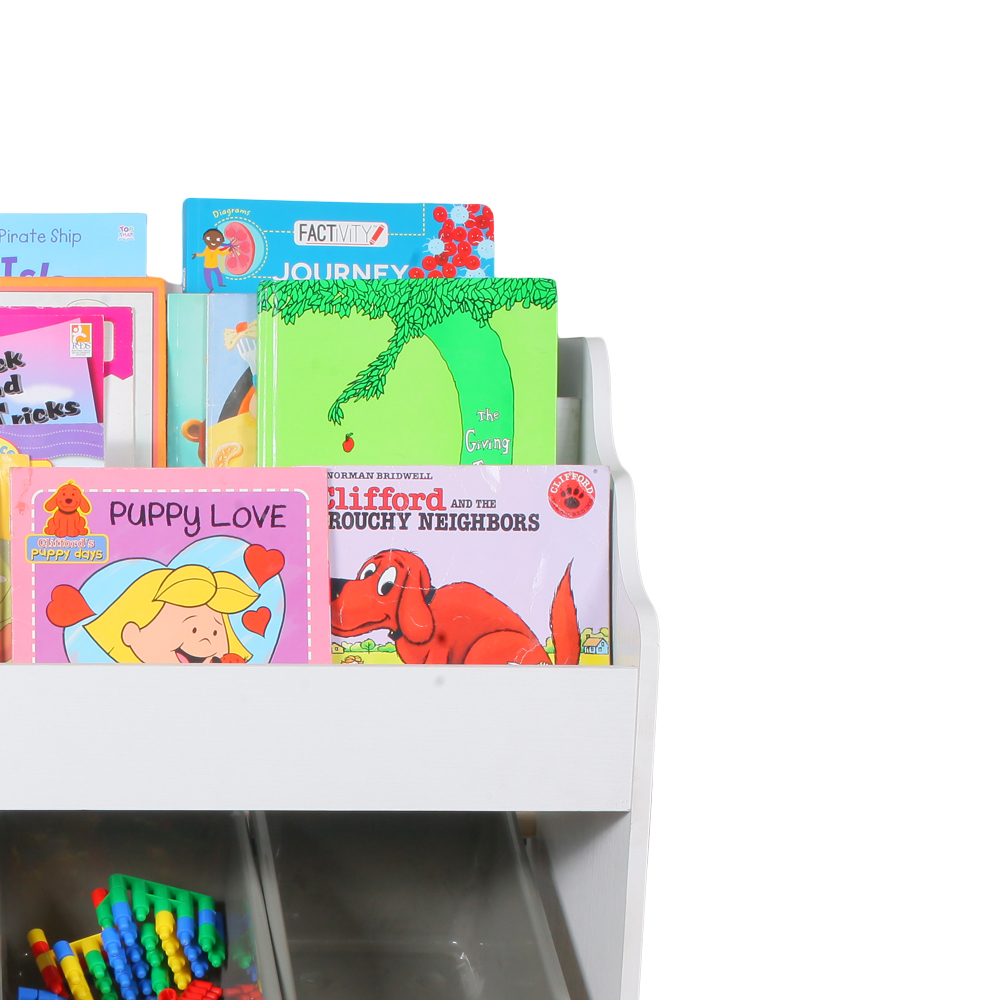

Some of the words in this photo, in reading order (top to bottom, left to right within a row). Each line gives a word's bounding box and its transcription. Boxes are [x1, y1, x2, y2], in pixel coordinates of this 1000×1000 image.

[212, 208, 251, 219] Diagrams
[119, 225, 134, 233] TOP
[50, 228, 82, 248] Ship
[272, 262, 410, 280] JOURNEY
[476, 408, 500, 422] The
[464, 428, 512, 455] Giving
[327, 472, 375, 480] NORMAN
[376, 472, 434, 480] BRIDWELL
[549, 472, 595, 495] CLIFFORD
[450, 499, 473, 509] AND
[475, 499, 497, 509] THE
[211, 503, 287, 528] LOVE
[329, 512, 412, 530] ROUCHY
[418, 512, 540, 532] NEIGHBORS
[37, 537, 96, 549] Clifford's
[30, 548, 71, 560] puppy
[73, 547, 103, 560] days
